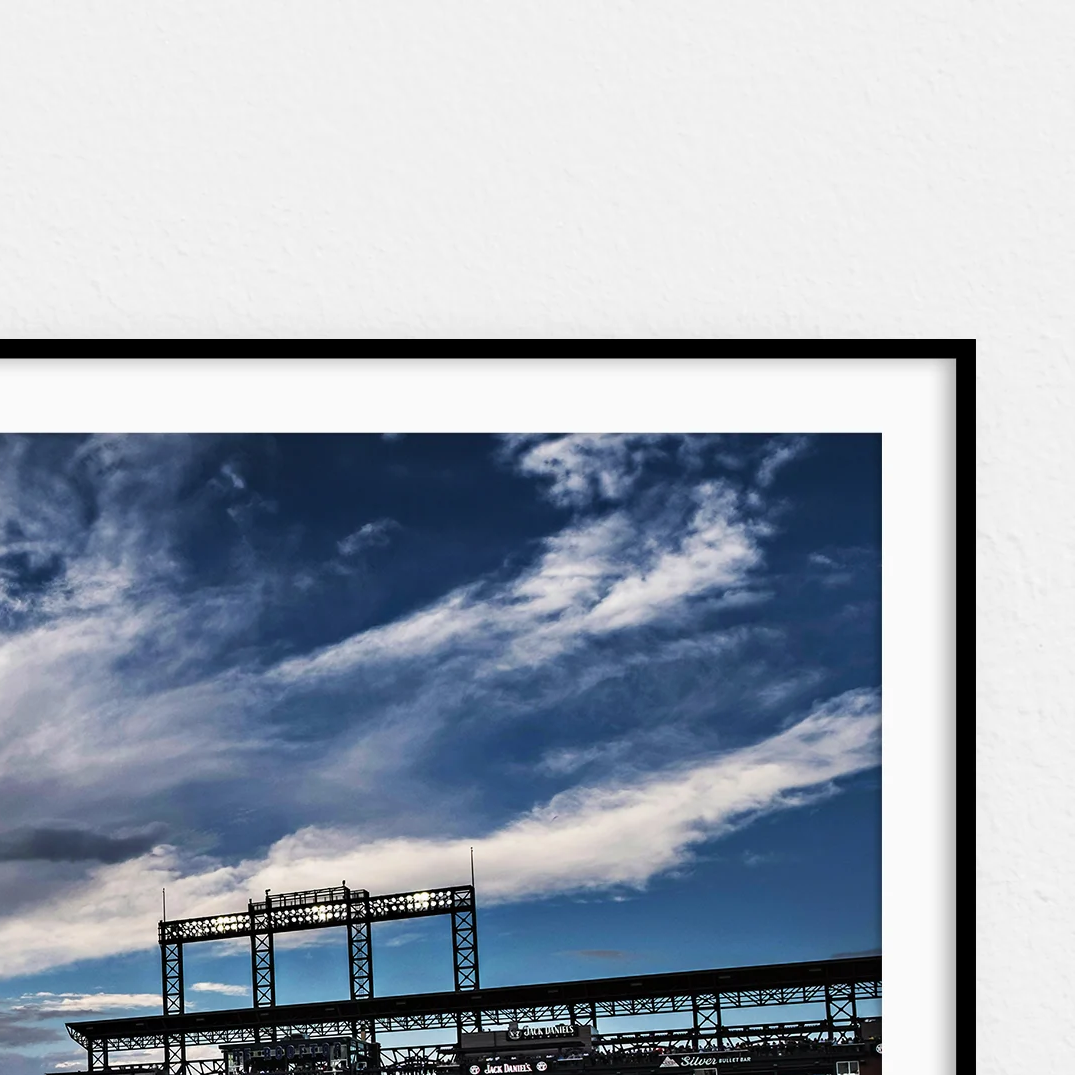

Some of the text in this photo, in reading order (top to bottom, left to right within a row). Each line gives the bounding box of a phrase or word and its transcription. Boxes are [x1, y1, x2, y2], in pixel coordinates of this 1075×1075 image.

[523, 1024, 574, 1036] JACK DANIEL'S
[680, 1056, 717, 1067] Silver
[484, 1063, 532, 1074] JACK DANIEL'S
